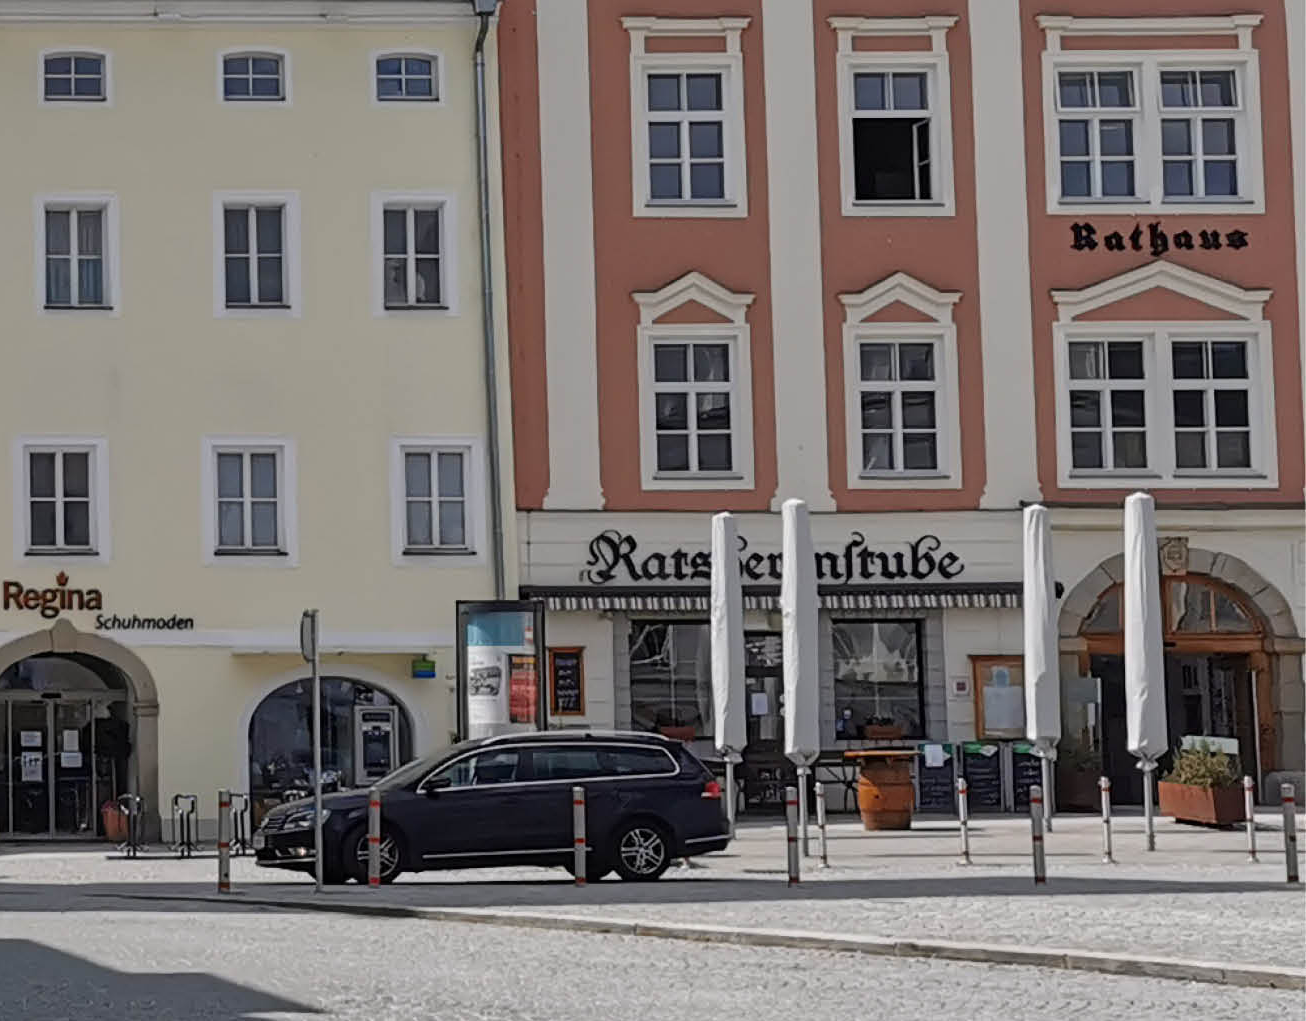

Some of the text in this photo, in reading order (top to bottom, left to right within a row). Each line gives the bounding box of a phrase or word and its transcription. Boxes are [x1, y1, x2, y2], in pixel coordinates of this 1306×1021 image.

[1070, 221, 1249, 257] Rathaus
[3, 581, 103, 619] Regina
[96, 614, 194, 630] Schuhmoden
